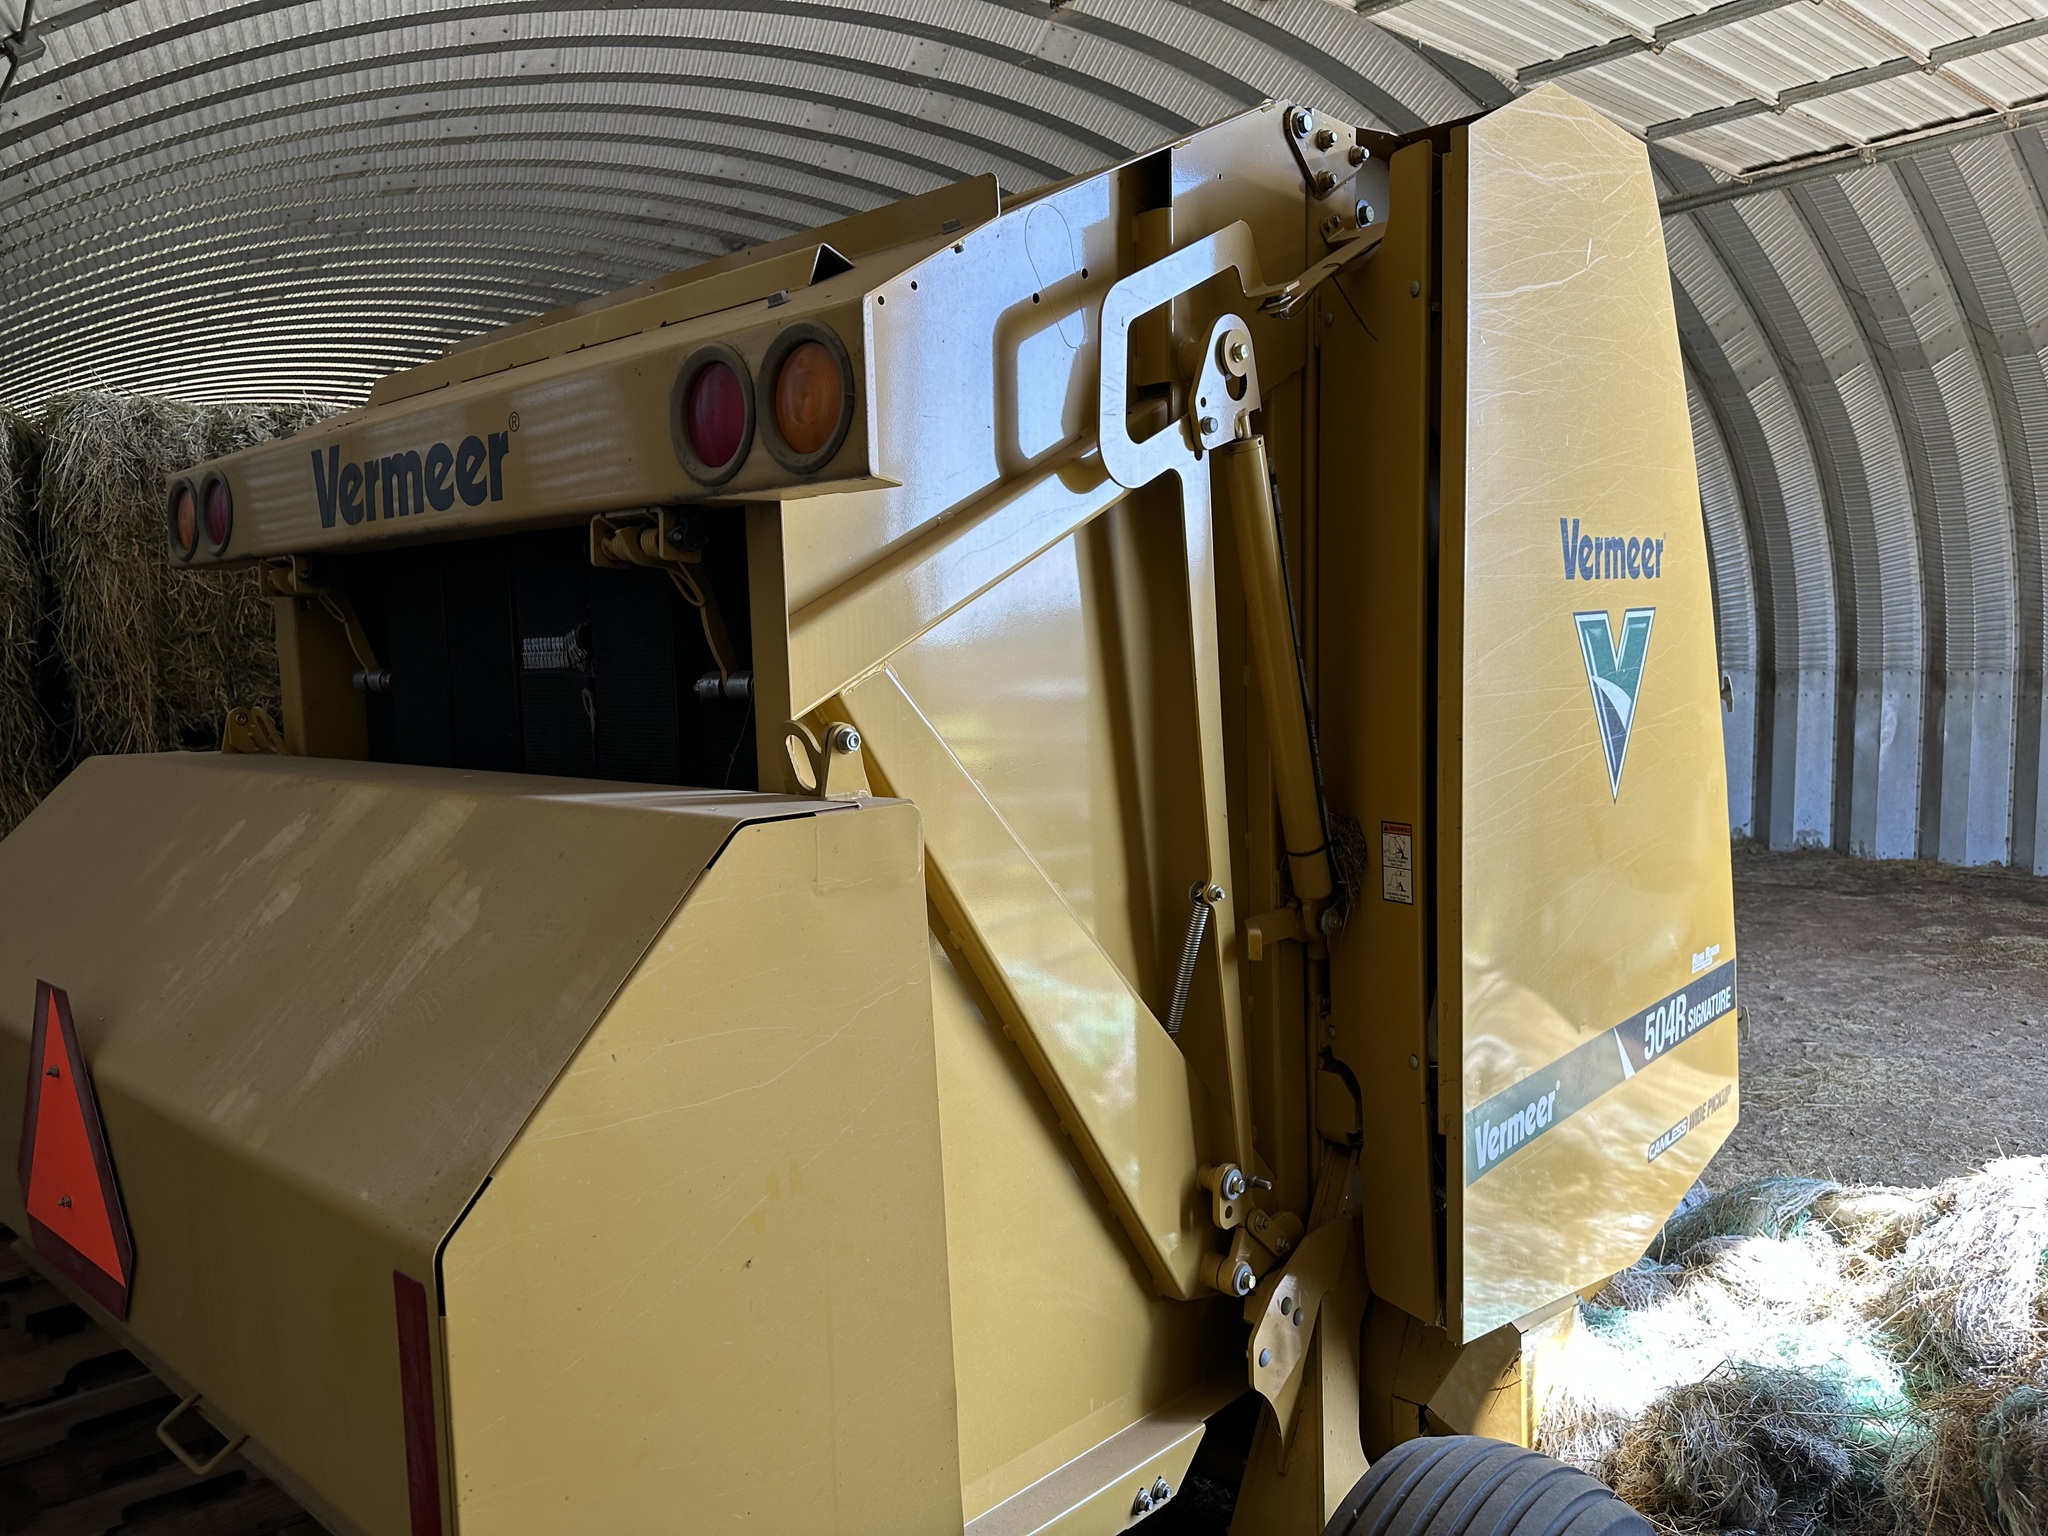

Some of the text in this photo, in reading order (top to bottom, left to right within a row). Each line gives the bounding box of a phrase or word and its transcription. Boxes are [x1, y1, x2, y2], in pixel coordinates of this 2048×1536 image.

[1644, 985, 1732, 1061] 504R SIGNATURE
[1648, 1083, 1732, 1160] CAMLESS WIDE PICKUP
